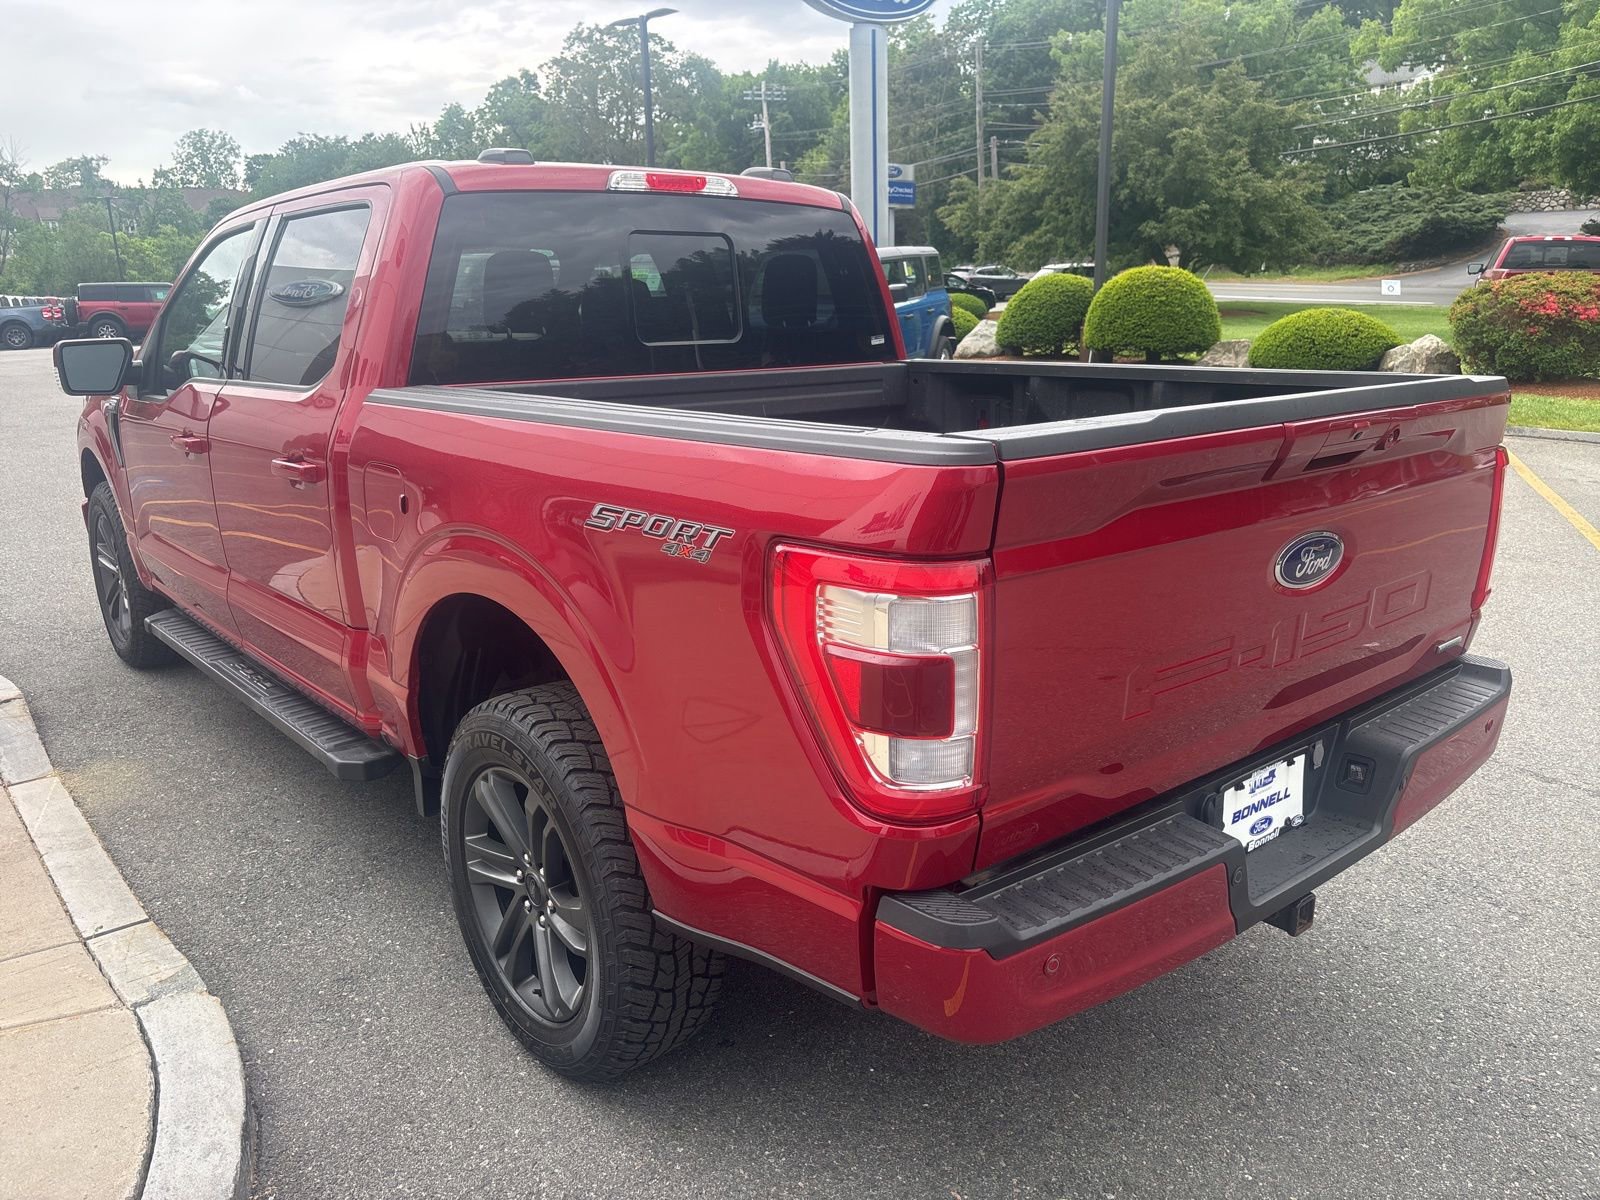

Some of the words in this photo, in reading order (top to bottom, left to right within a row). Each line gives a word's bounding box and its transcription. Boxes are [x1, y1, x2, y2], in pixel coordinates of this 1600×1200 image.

[584, 502, 736, 551] SPORT
[457, 731, 557, 811] RAVELSTAR
[1231, 787, 1291, 825] BONNELL
[1247, 826, 1280, 852] Bonnell
